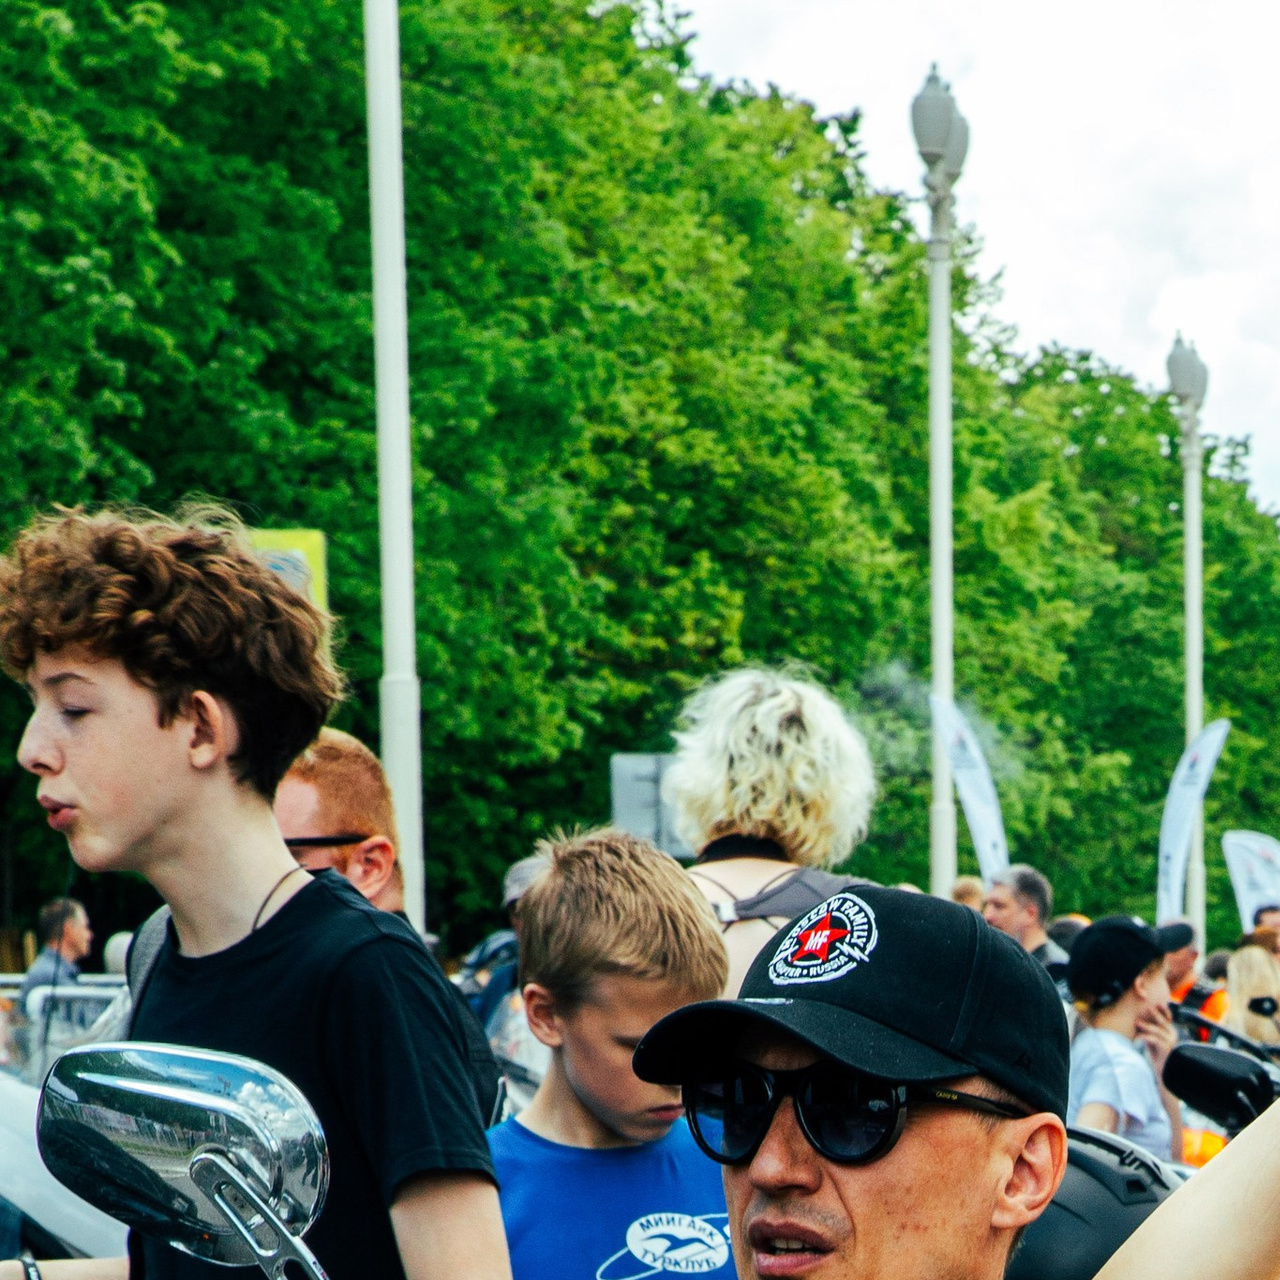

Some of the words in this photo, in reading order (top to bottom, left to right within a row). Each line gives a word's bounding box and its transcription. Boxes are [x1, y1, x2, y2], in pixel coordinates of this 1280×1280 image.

[840, 901, 869, 948] FAMILY
[803, 930, 831, 951] MF
[809, 955, 849, 977] RUSSIA
